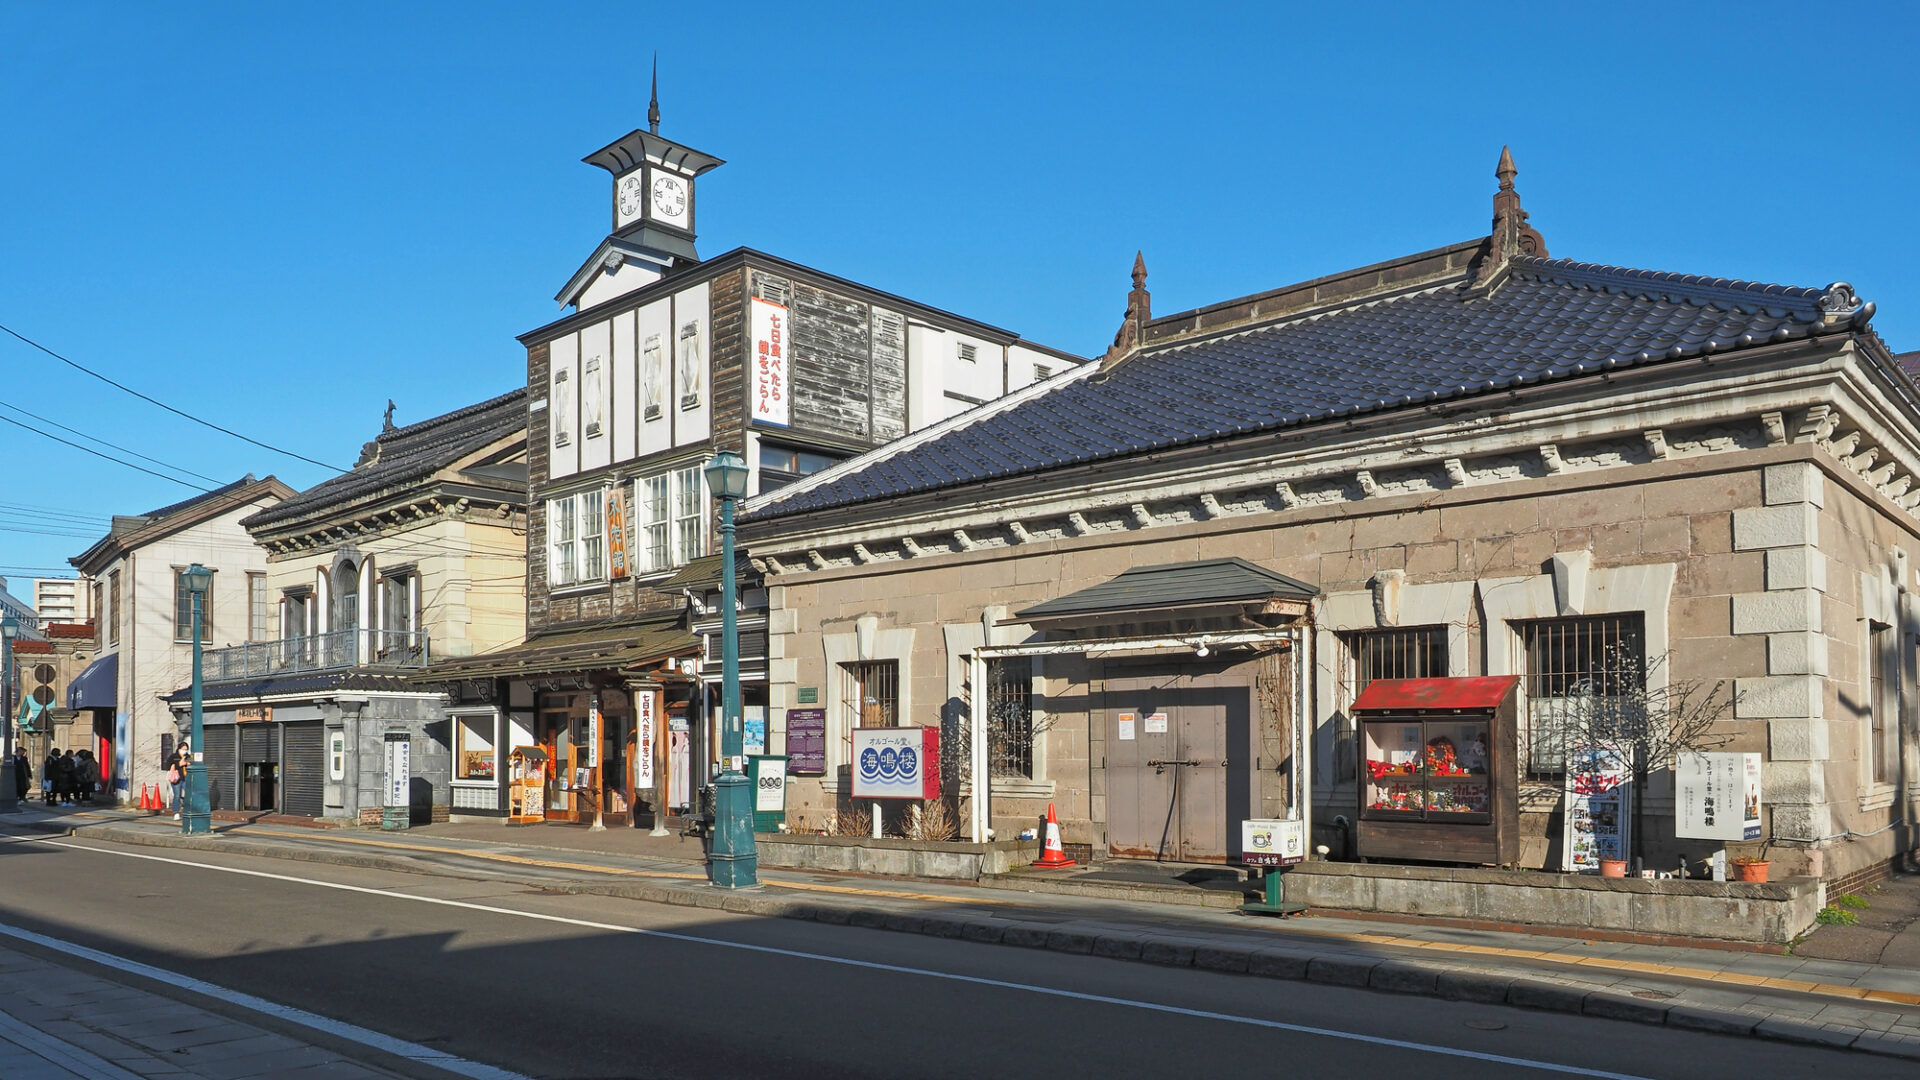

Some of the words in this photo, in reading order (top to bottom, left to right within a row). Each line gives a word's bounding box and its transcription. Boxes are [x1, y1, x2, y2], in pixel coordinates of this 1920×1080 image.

[665, 180, 674, 191] XII
[758, 339, 770, 414] 鏡をごらん
[770, 313, 781, 402] 七日食べたら
[608, 497, 624, 569] 不老館
[641, 694, 650, 778] 七日食べたら鏡をごらん
[861, 751, 916, 770] 海鳴楼
[1704, 796, 1715, 827] 海鳴楼
